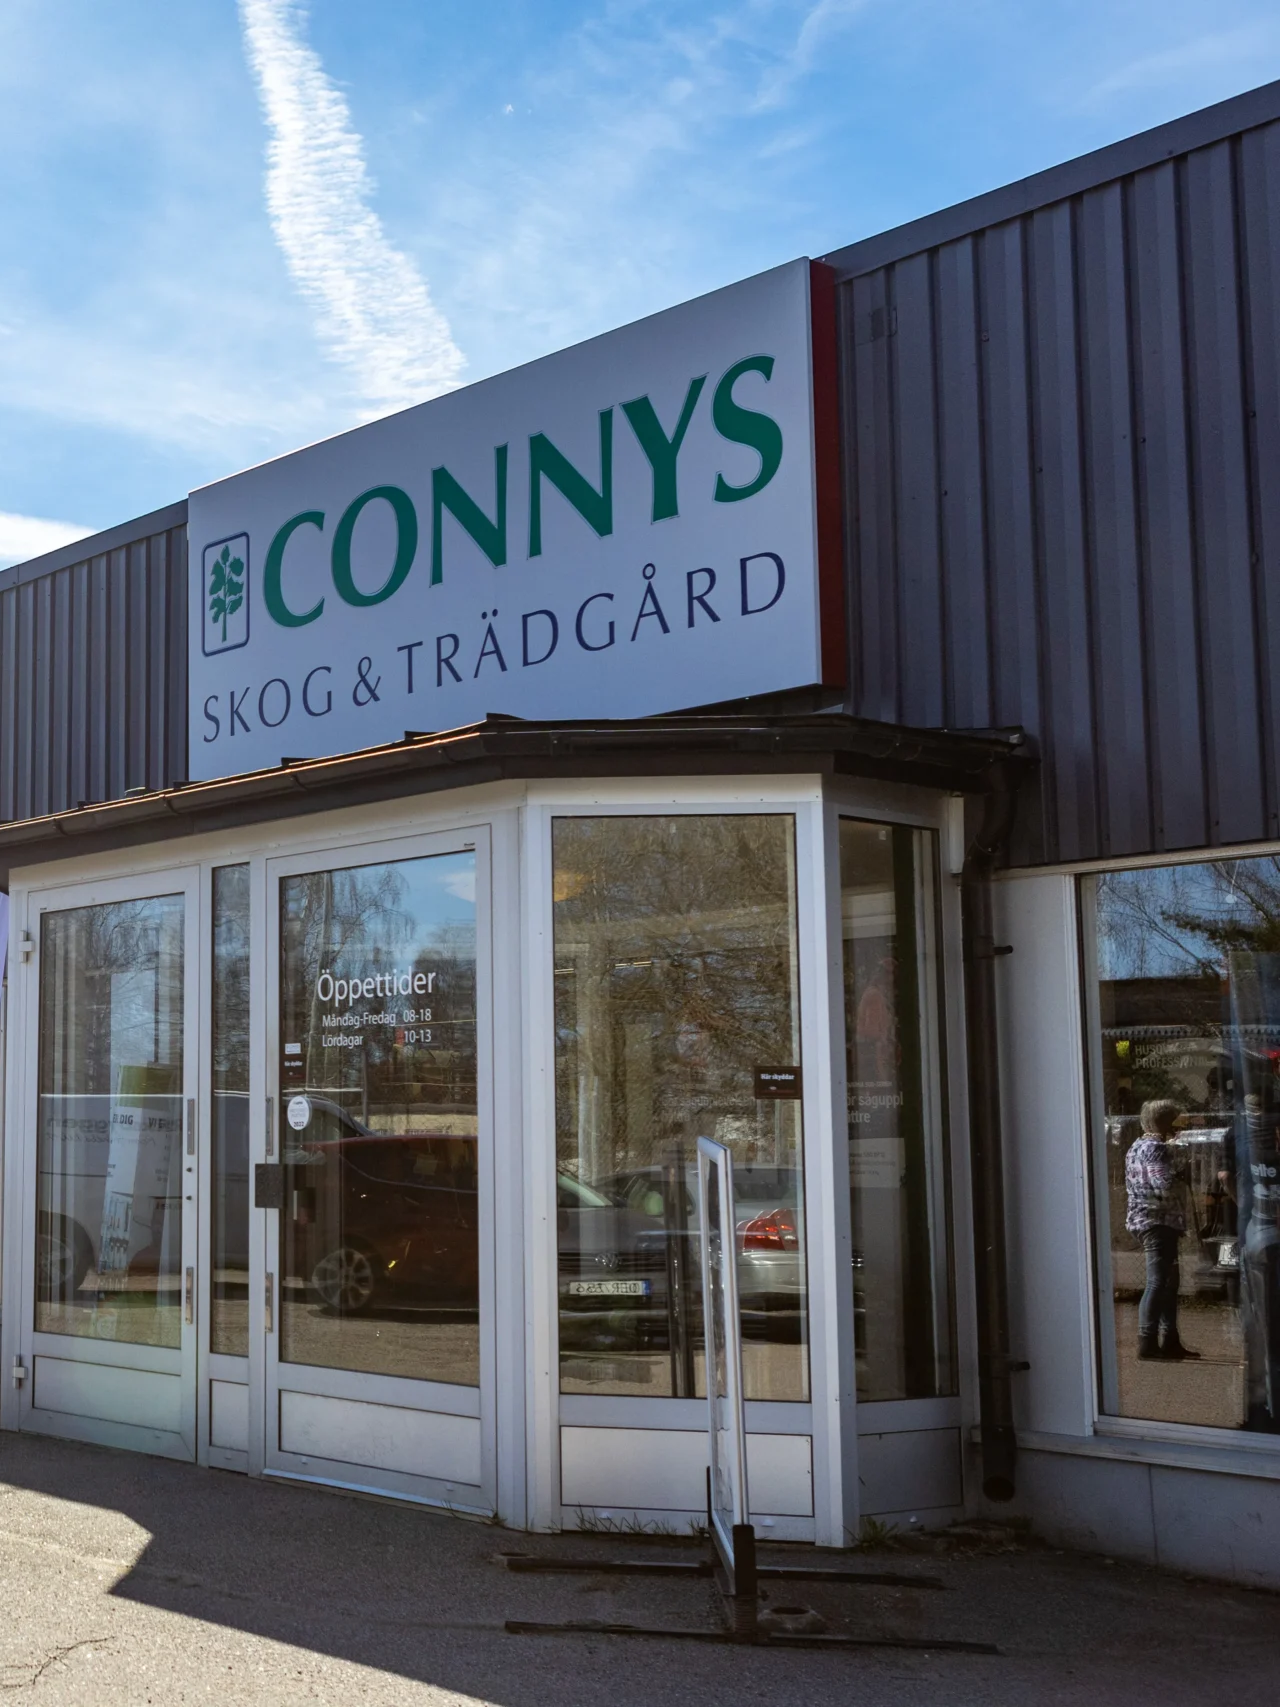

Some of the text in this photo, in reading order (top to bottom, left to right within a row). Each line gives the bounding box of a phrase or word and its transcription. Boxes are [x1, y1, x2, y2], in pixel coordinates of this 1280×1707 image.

[262, 353, 784, 628] CONNYS
[203, 551, 786, 742] SKOG & TRÄDGÅRD
[318, 966, 436, 1007] Öppettider
[322, 1009, 431, 1028] Måndag-Fredag 08-18
[322, 1029, 431, 1049] Lördagar 10-13
